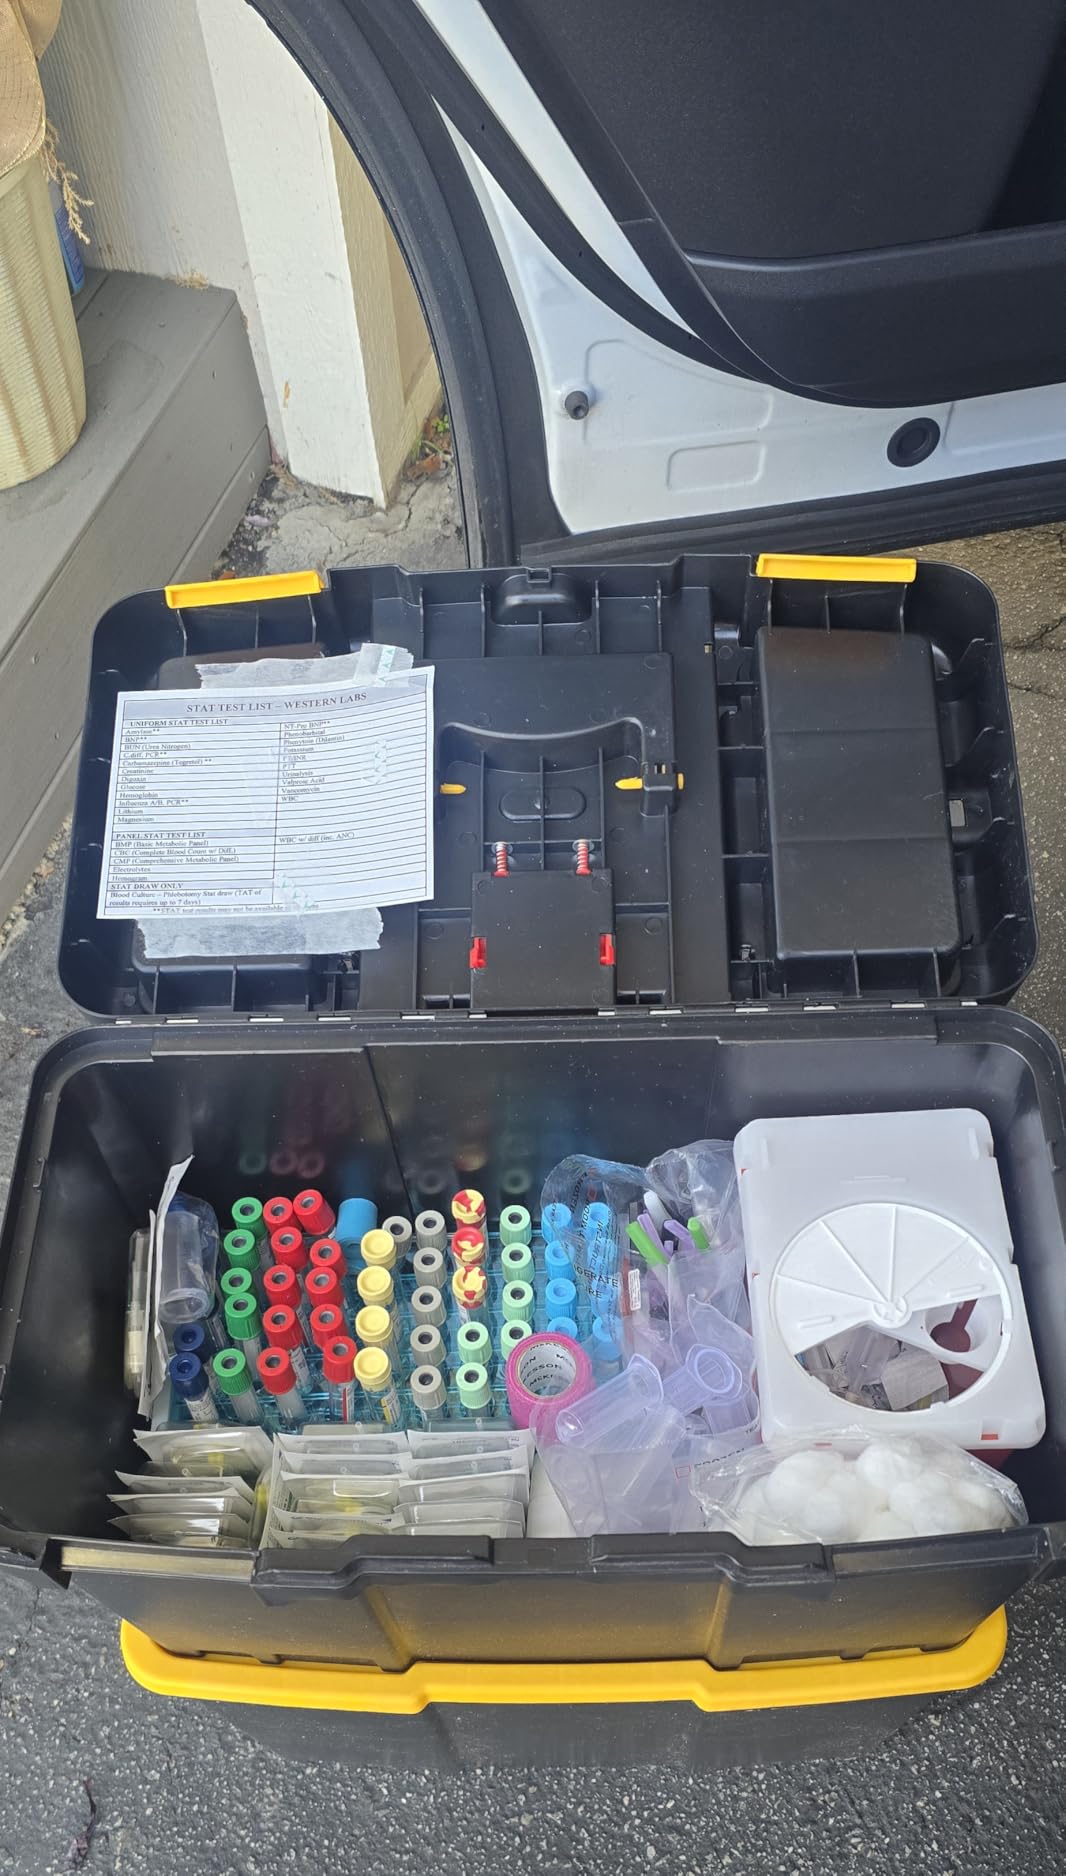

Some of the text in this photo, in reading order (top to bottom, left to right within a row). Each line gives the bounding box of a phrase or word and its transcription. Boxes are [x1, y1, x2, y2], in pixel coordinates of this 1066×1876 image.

[187, 704, 216, 712] STAT
[285, 698, 337, 709] WESTERN
[340, 693, 366, 703] LABS
